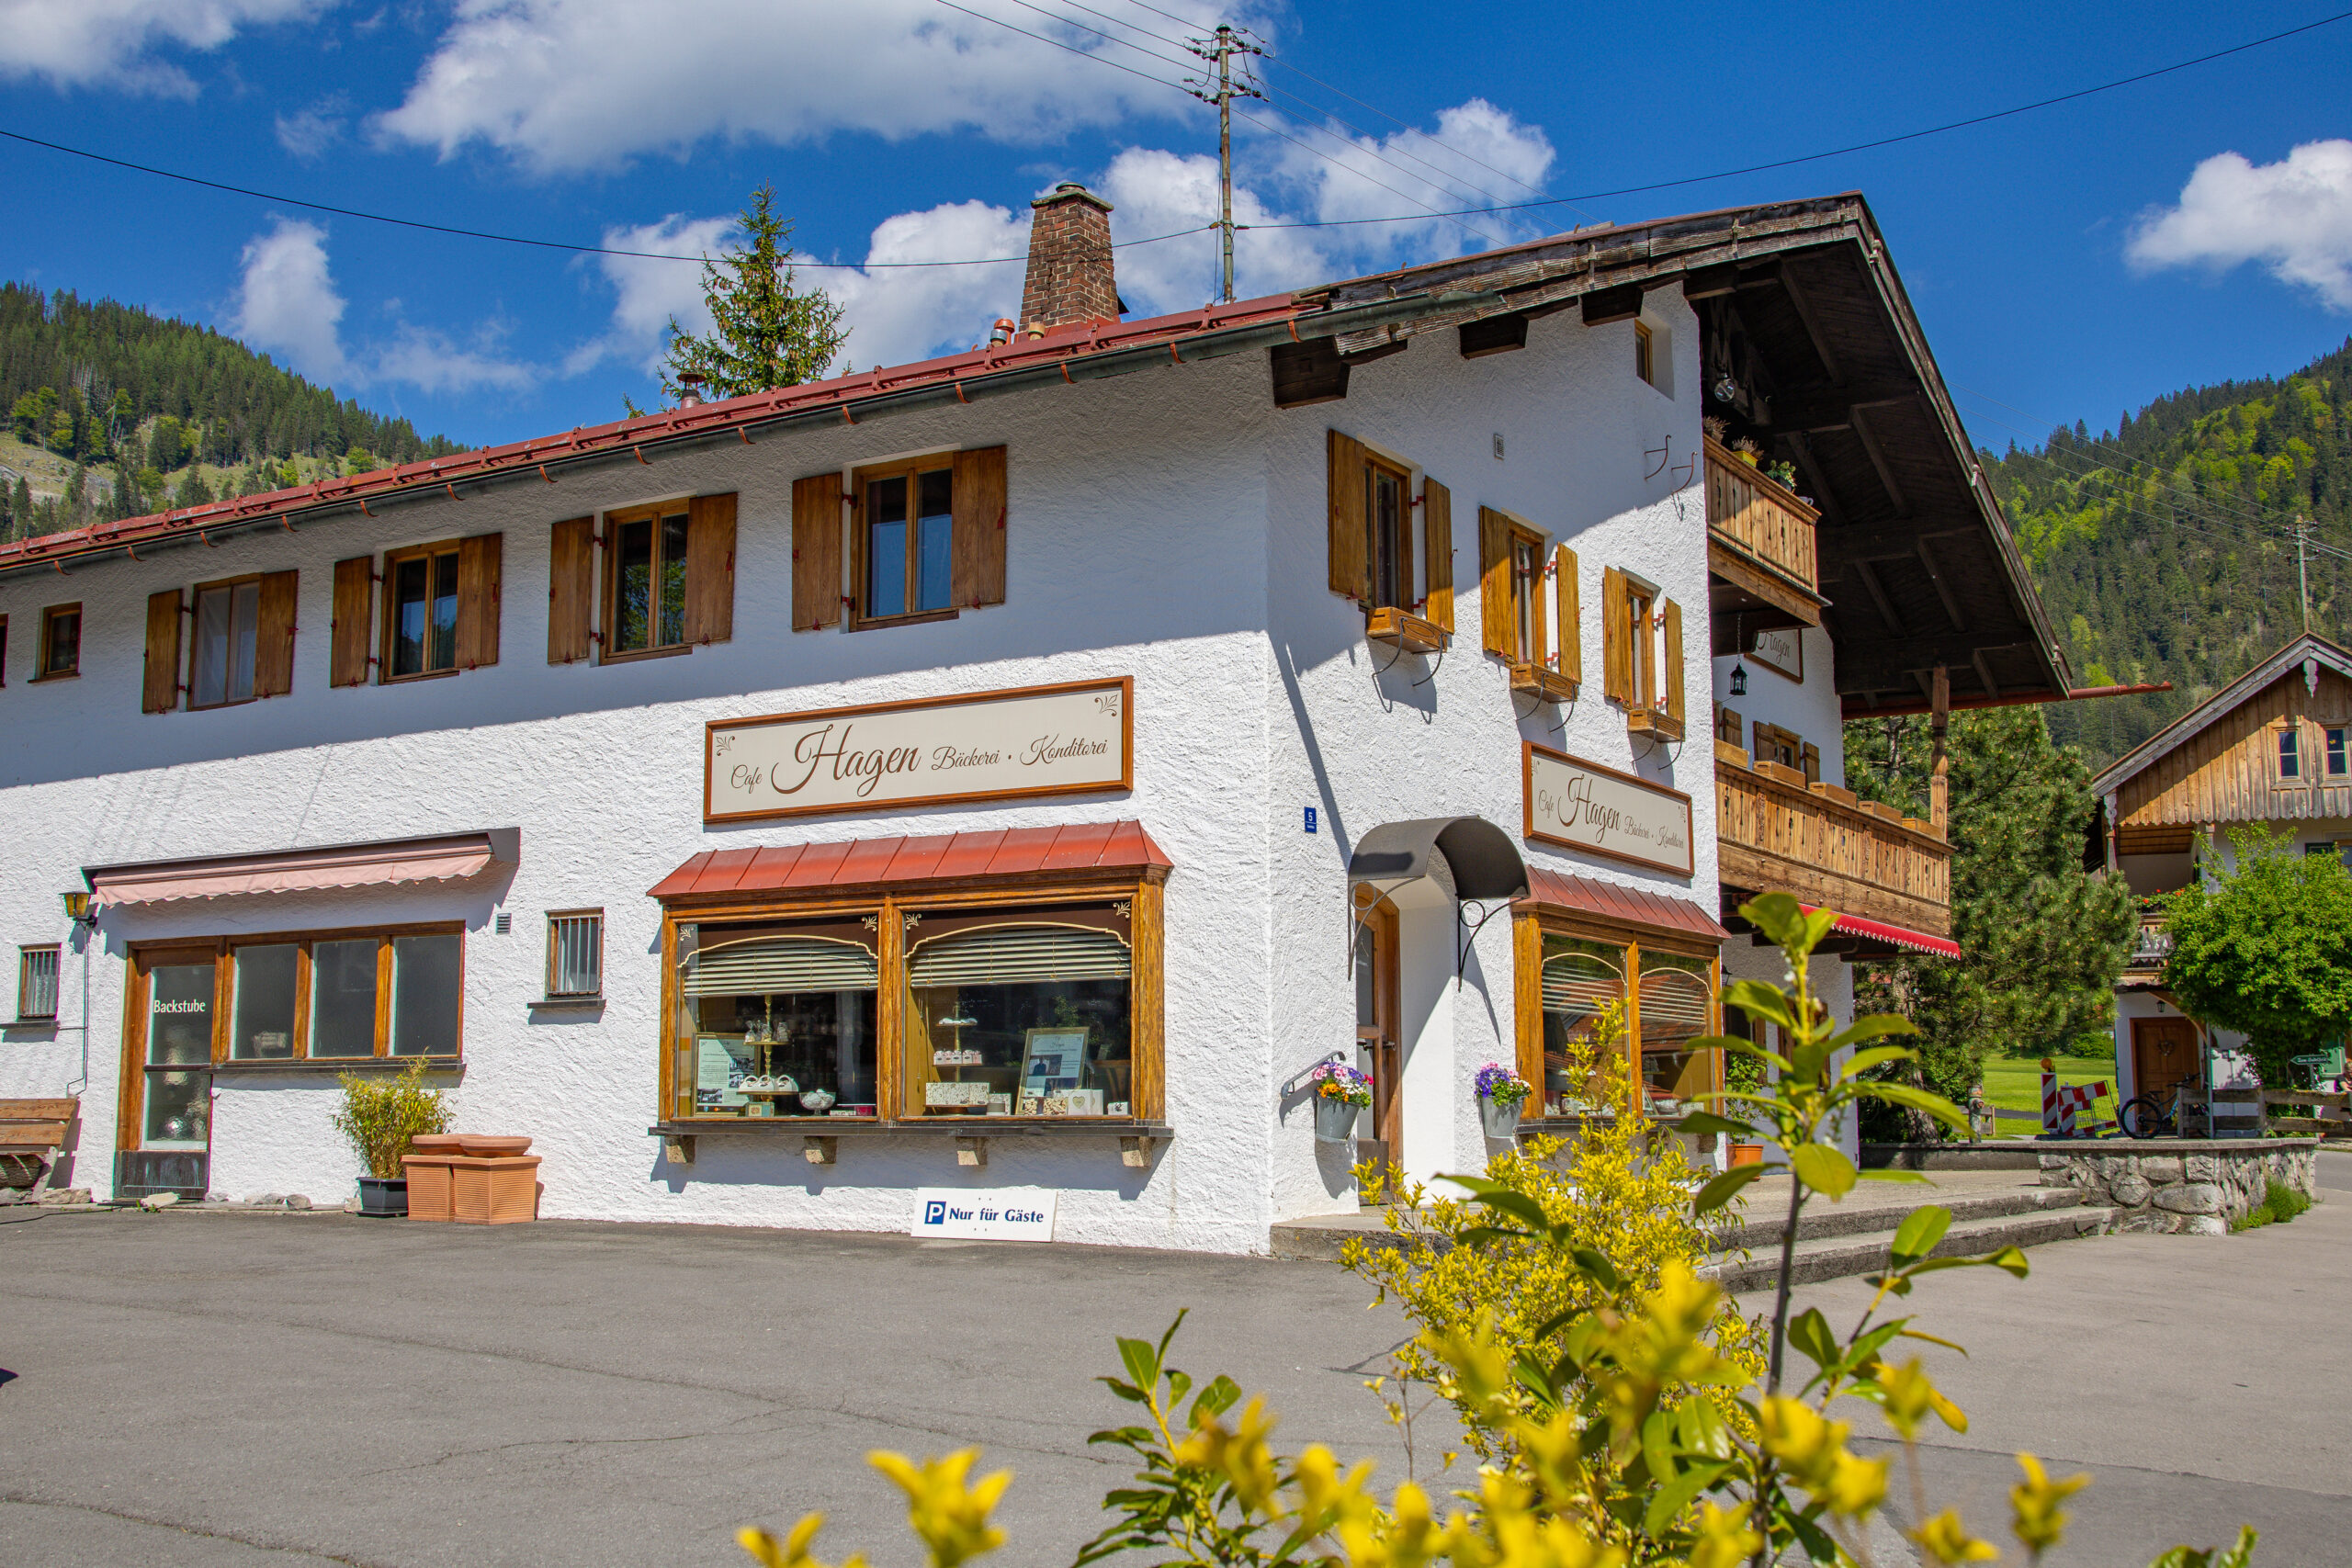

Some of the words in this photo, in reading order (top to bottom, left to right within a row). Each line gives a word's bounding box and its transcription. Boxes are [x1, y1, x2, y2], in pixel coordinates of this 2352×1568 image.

[730, 764, 763, 794] Cafe
[771, 724, 920, 796] Hagen
[932, 746, 1000, 771] Bäckerei
[1019, 733, 1108, 766] Konditorei
[1538, 789, 1554, 818] Cafe
[1557, 773, 1621, 843] Hagen
[153, 998, 206, 1013] Backstube
[949, 1207, 974, 1221] Nur
[979, 1207, 999, 1221] für
[1004, 1209, 1044, 1223] Gäste
